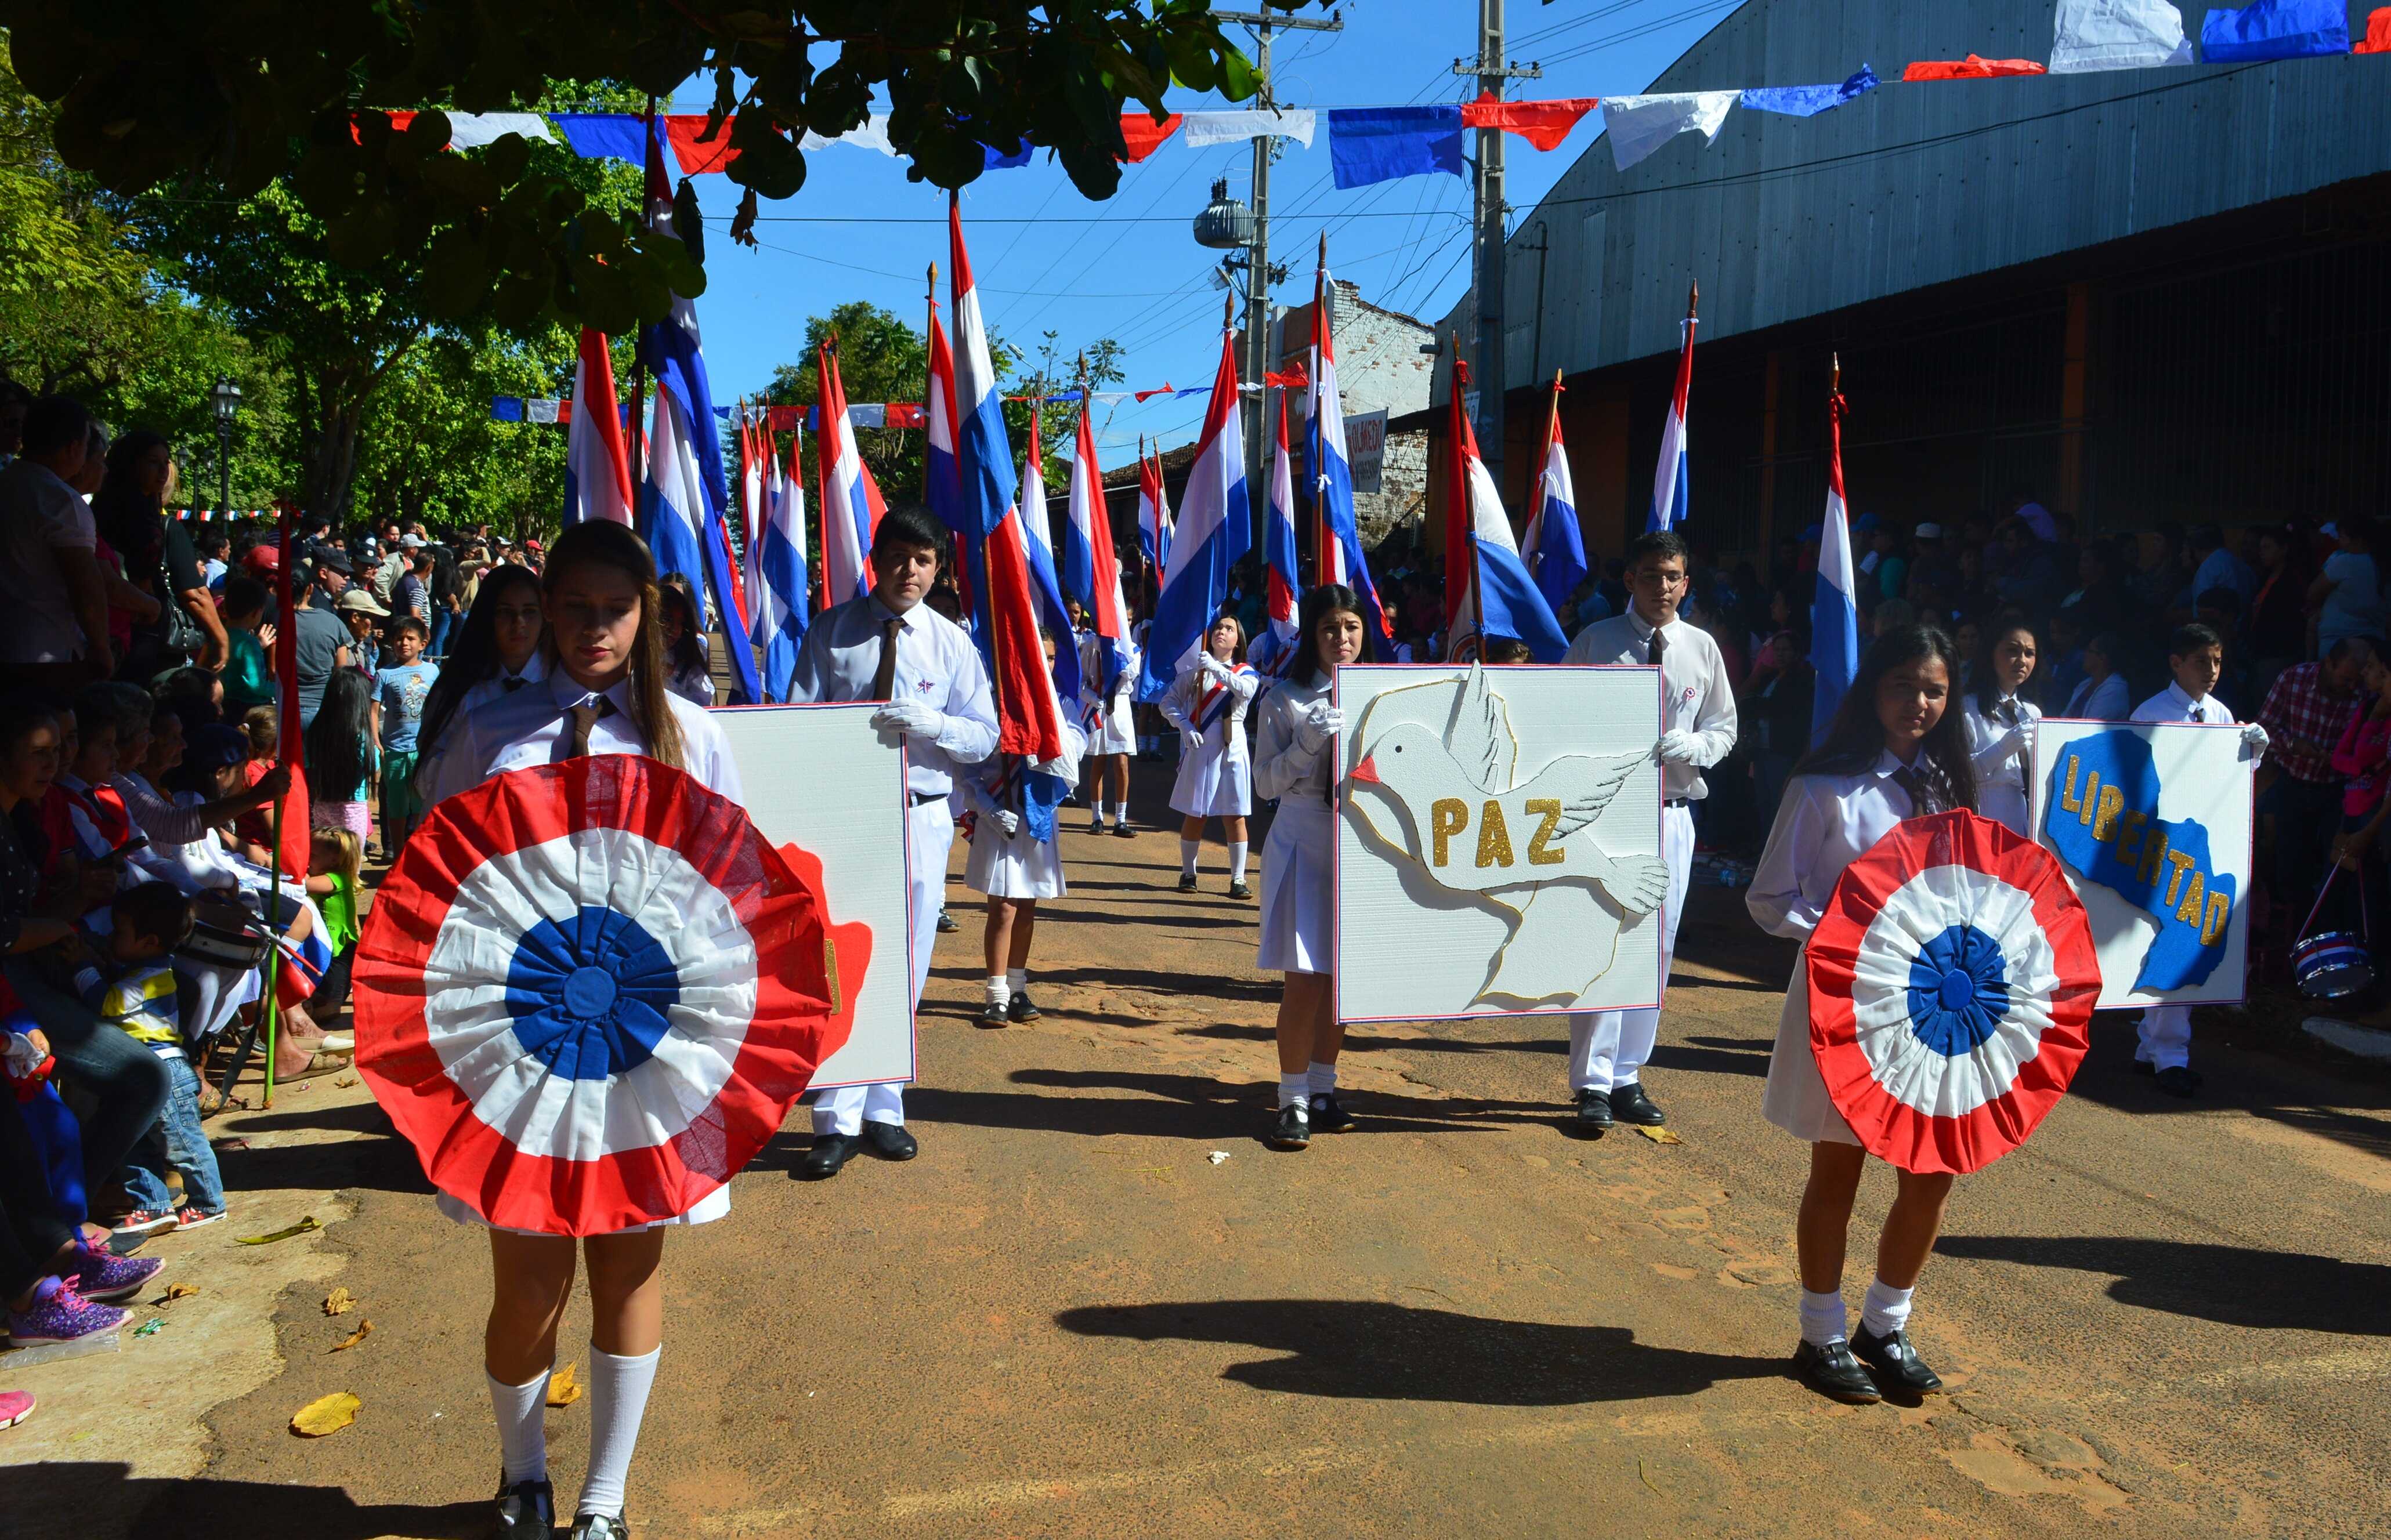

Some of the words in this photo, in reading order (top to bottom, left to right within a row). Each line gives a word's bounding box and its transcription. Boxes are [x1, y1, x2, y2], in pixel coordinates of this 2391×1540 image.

[1352, 419, 1383, 454] OLMEDO
[1431, 797, 1566, 868] PAZ
[2061, 755, 2229, 948] LIBERTAD
